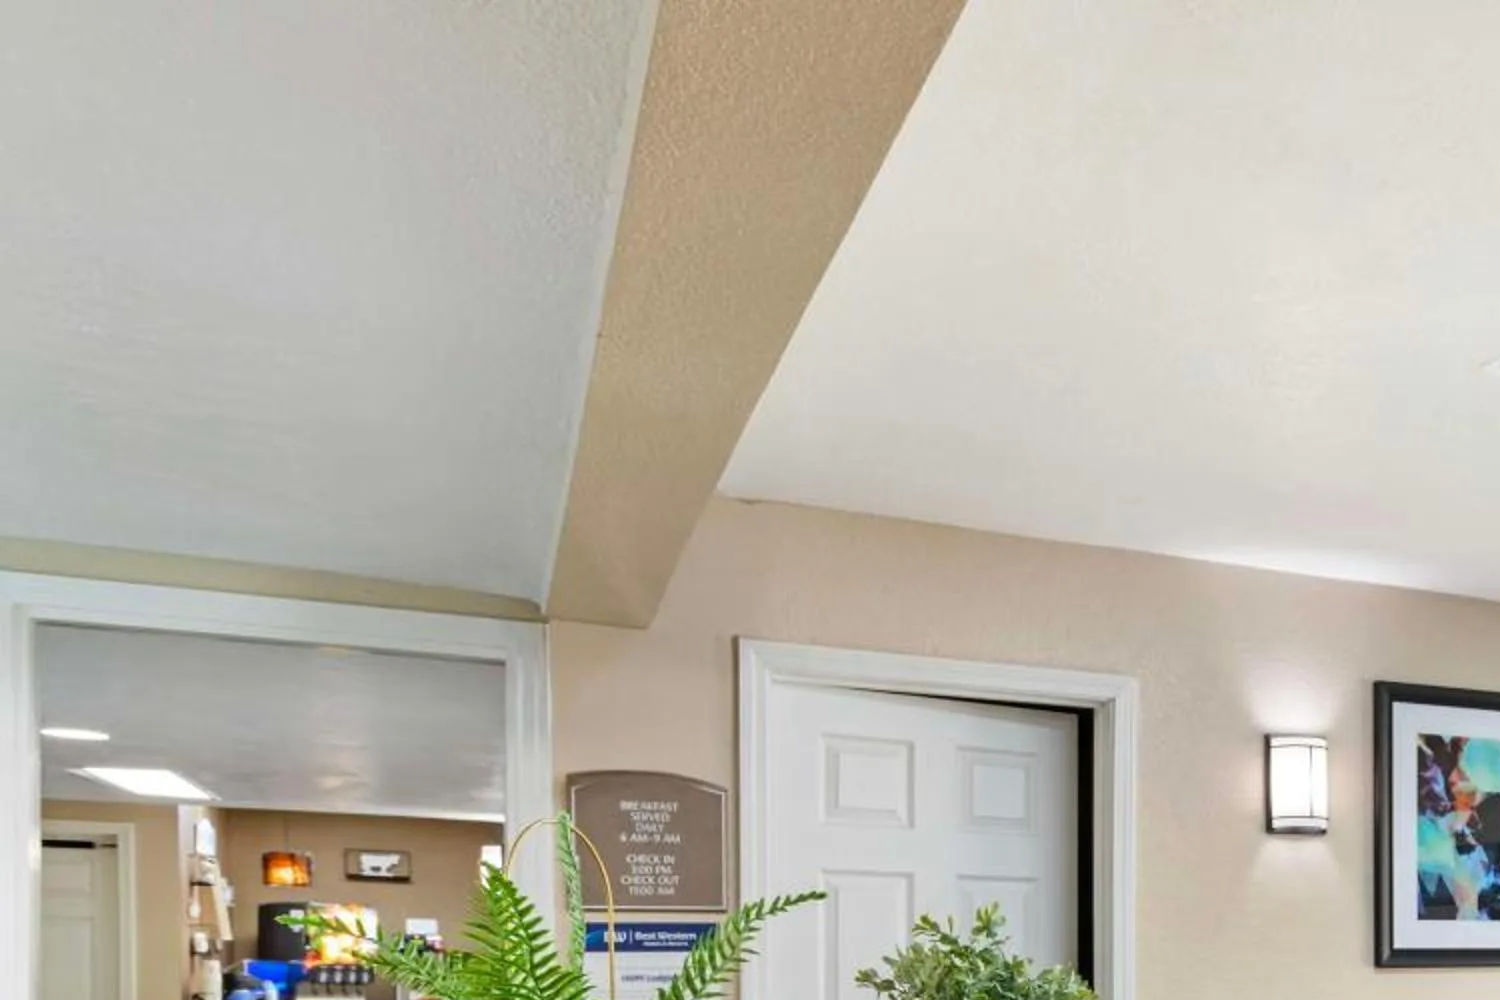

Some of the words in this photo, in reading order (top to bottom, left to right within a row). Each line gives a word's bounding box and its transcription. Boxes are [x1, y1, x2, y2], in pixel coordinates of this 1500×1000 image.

[620, 800, 679, 812] BREAKFAST
[630, 811, 671, 822] SERVED
[626, 854, 661, 864] CHECK
[663, 855, 675, 865] IN
[621, 875, 656, 885] CHECK
[657, 876, 680, 886] OUT
